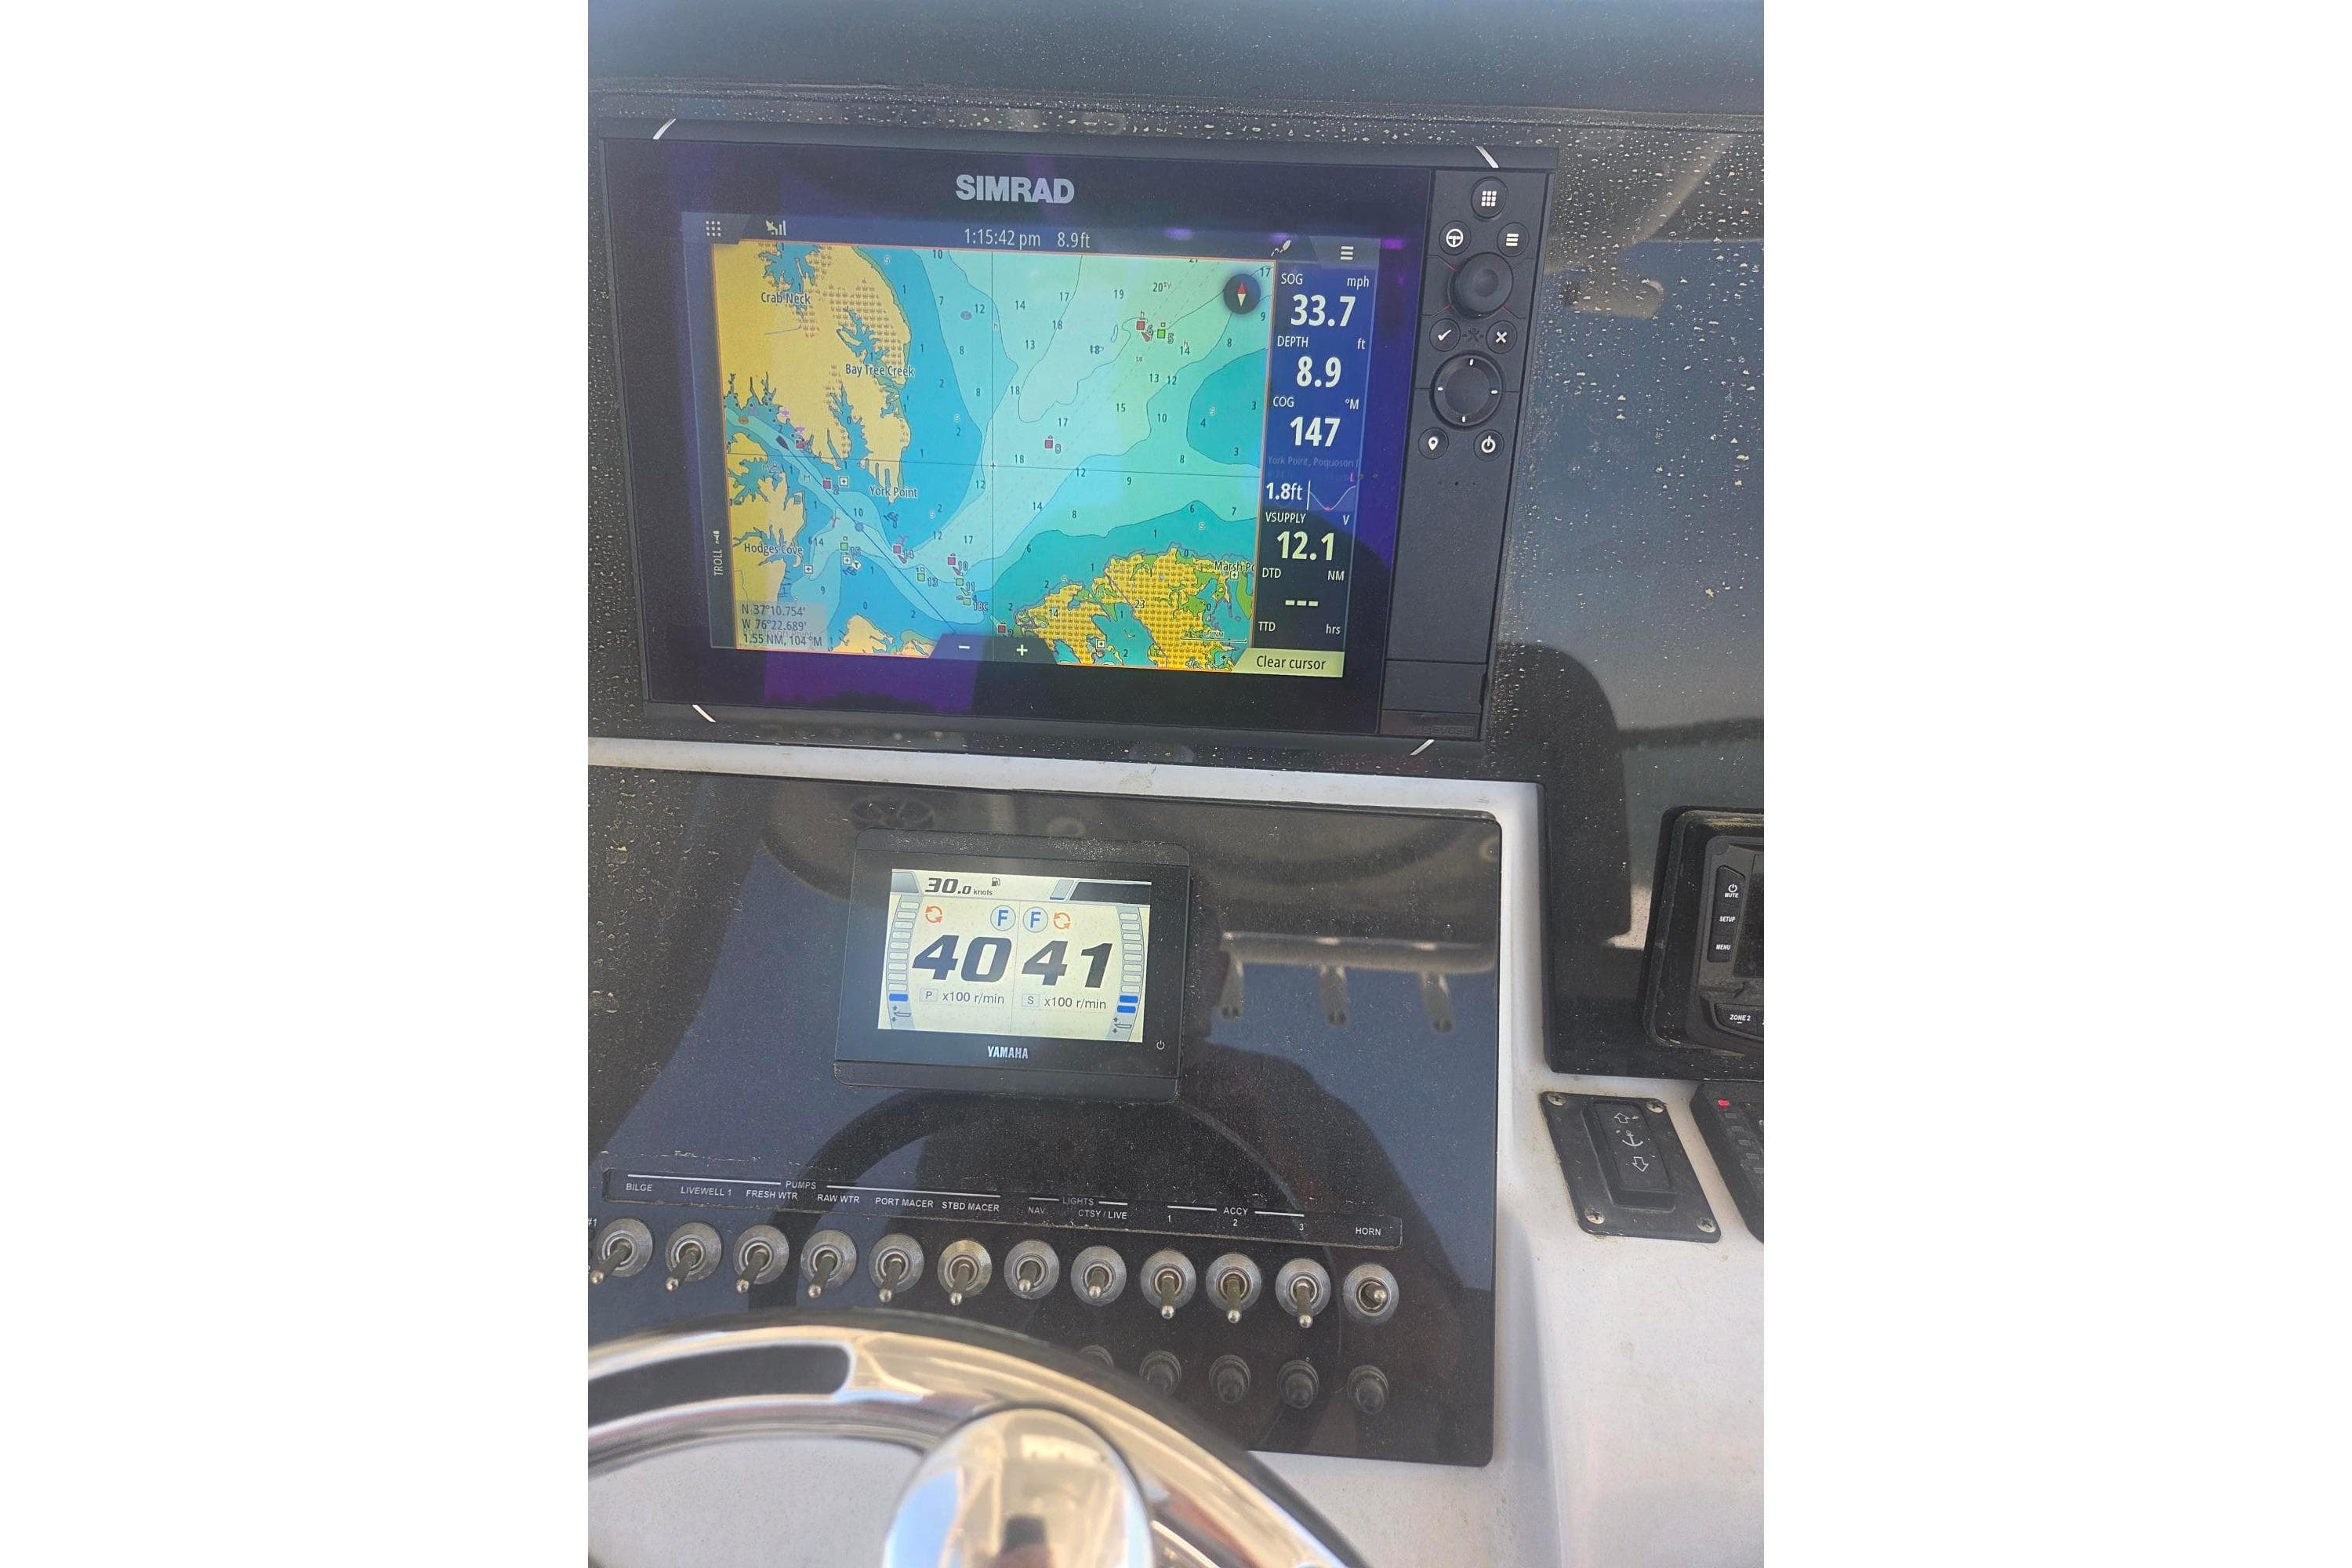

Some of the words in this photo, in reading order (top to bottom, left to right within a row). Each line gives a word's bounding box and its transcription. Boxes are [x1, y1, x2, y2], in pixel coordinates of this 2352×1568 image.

[956, 174, 1075, 204] SIMRAD
[964, 228, 1015, 245] 1:15:42
[1019, 233, 1041, 250] pm
[1281, 274, 1303, 285] SOG
[1347, 276, 1370, 290] mph
[761, 292, 782, 303] Crab
[786, 293, 811, 304] Neck
[1290, 294, 1356, 327] 33.7
[1277, 336, 1308, 347] DEPTH
[1357, 338, 1366, 350] ft
[846, 365, 862, 377] Bay
[865, 365, 885, 376] Tree
[888, 365, 915, 377] Creek
[1296, 356, 1341, 387] 8.9
[1273, 397, 1294, 408] COG
[1345, 398, 1359, 410] °M
[1290, 416, 1341, 447] 147
[869, 486, 890, 497] York
[894, 488, 917, 498] Point
[1265, 512, 1306, 524] VSUPPLY
[1343, 514, 1349, 525] V
[744, 543, 778, 556] Hodges
[781, 545, 803, 555] Cove
[1276, 531, 1334, 561] 12.1
[713, 549, 724, 576] TROLL
[1215, 561, 1243, 571] Marsh
[1261, 568, 1281, 579] DTD
[1327, 570, 1345, 582] NM
[742, 604, 749, 614] N
[742, 619, 750, 629] W
[1258, 621, 1276, 632] TTD
[1326, 624, 1341, 635] hrs
[744, 633, 764, 644] 1.55
[766, 634, 786, 646] NM,
[789, 636, 807, 646] 104
[1257, 655, 1286, 669] Clear
[1289, 659, 1326, 670] cursor
[924, 877, 971, 895] 30.0
[974, 887, 993, 897] knots
[997, 909, 1009, 926] F
[1030, 911, 1041, 927] F
[912, 935, 1012, 982] 40
[1022, 940, 1112, 988] 41
[942, 991, 971, 1004] x100
[974, 992, 1005, 1005] r/min
[1027, 996, 1034, 1005] S
[1044, 996, 1073, 1007] x100
[1076, 997, 1106, 1010] r/min
[988, 1046, 1029, 1059] YAMAHA
[626, 1183, 652, 1192] BILGE
[681, 1186, 724, 1196] LIVEWELL
[786, 1180, 817, 1189] PUMPS
[746, 1189, 776, 1199] FRESH
[778, 1192, 798, 1200] WTR
[818, 1194, 839, 1203] RAW
[840, 1195, 860, 1204] WTR
[875, 1197, 900, 1207] PORT
[902, 1199, 934, 1208] MACER
[942, 1201, 966, 1210] STBD
[968, 1203, 1000, 1212] MACER
[1062, 1197, 1094, 1206] LIGHTS
[1078, 1209, 1101, 1218] CTSY
[1109, 1210, 1127, 1220] LIVE
[1223, 1207, 1249, 1216] ACCY
[1167, 1214, 1171, 1223] 1
[1232, 1218, 1238, 1227] 2
[1299, 1223, 1304, 1232] 3
[1356, 1227, 1381, 1236] HORN
